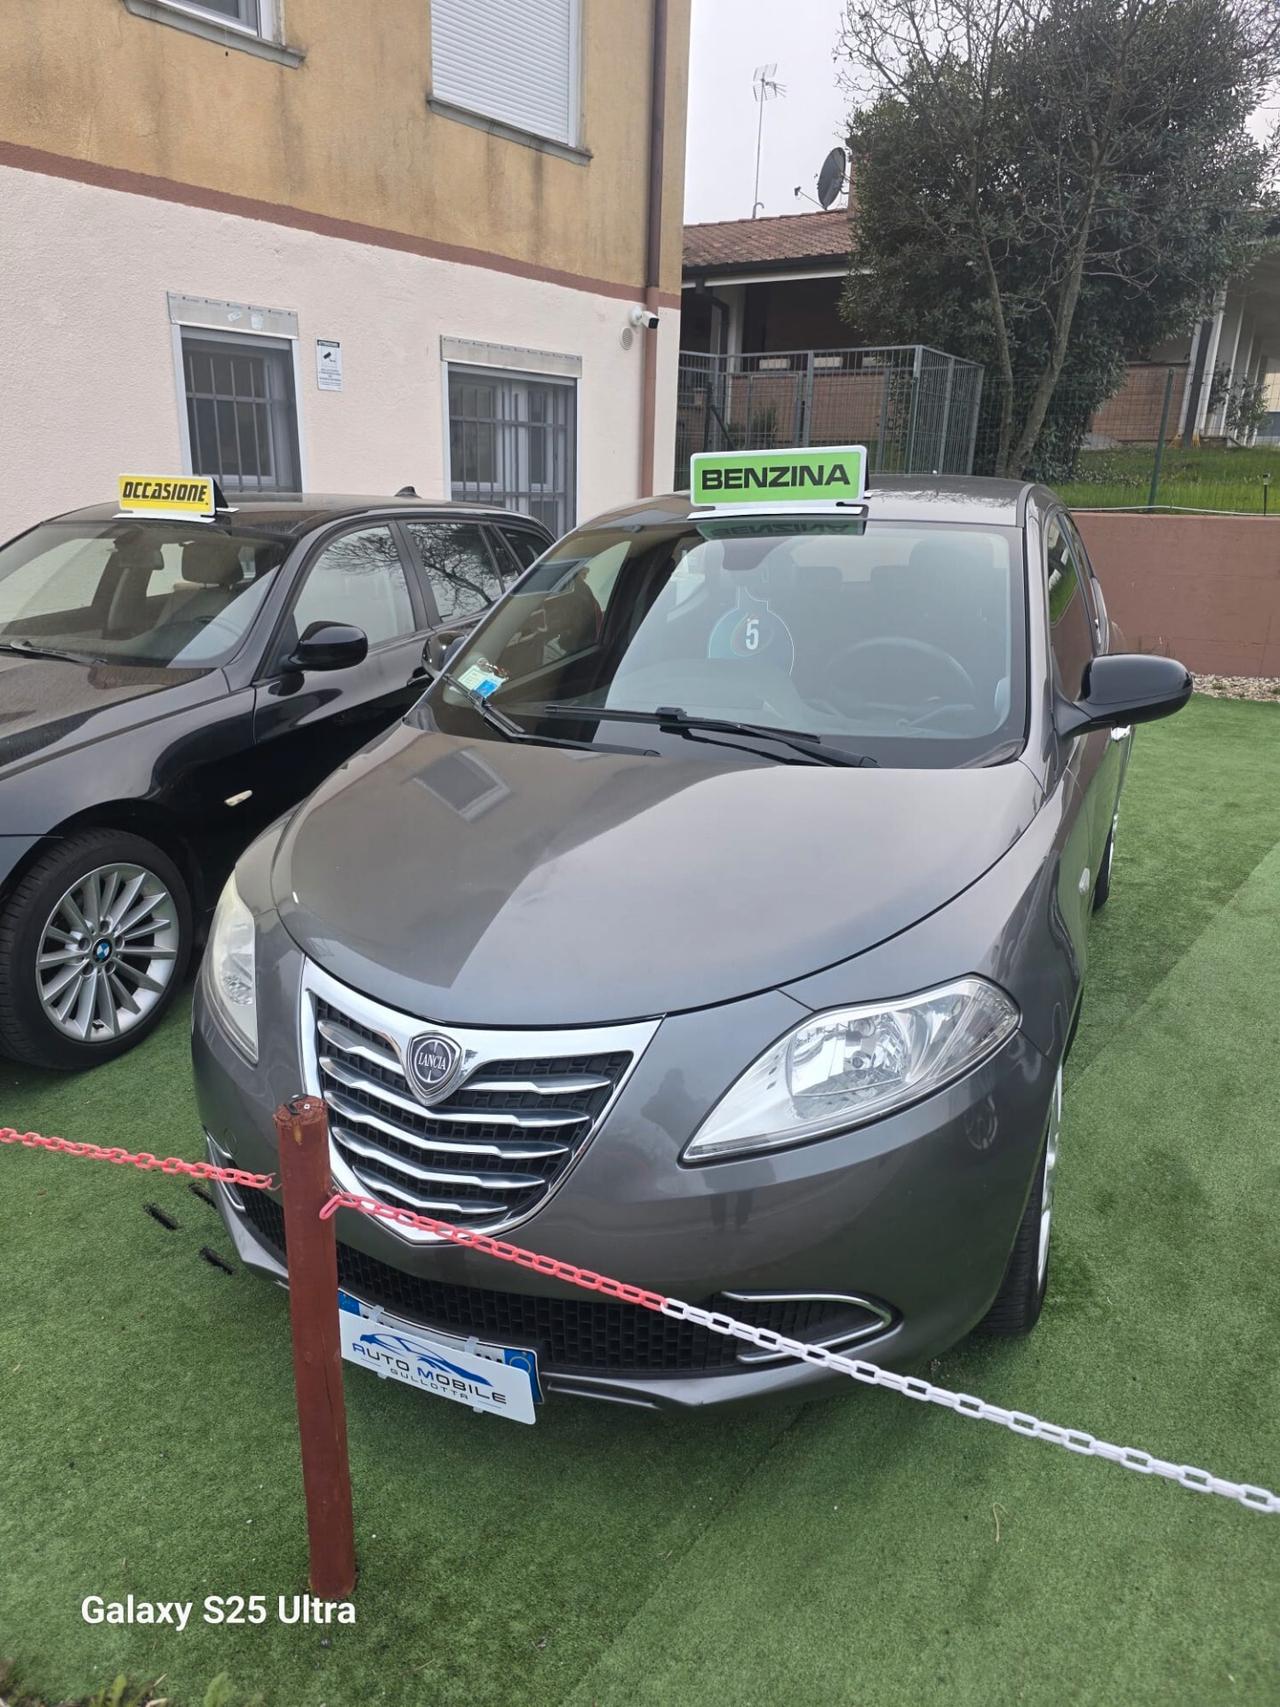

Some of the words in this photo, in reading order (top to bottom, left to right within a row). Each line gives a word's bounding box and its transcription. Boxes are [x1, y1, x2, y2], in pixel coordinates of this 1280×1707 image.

[701, 463, 851, 490] BENZINA
[745, 619, 759, 650] 5
[418, 1052, 446, 1070] LANCIA
[352, 1342, 410, 1372] AUTO
[417, 1366, 507, 1404] MOBILE
[390, 1368, 469, 1400] GULLOTTA
